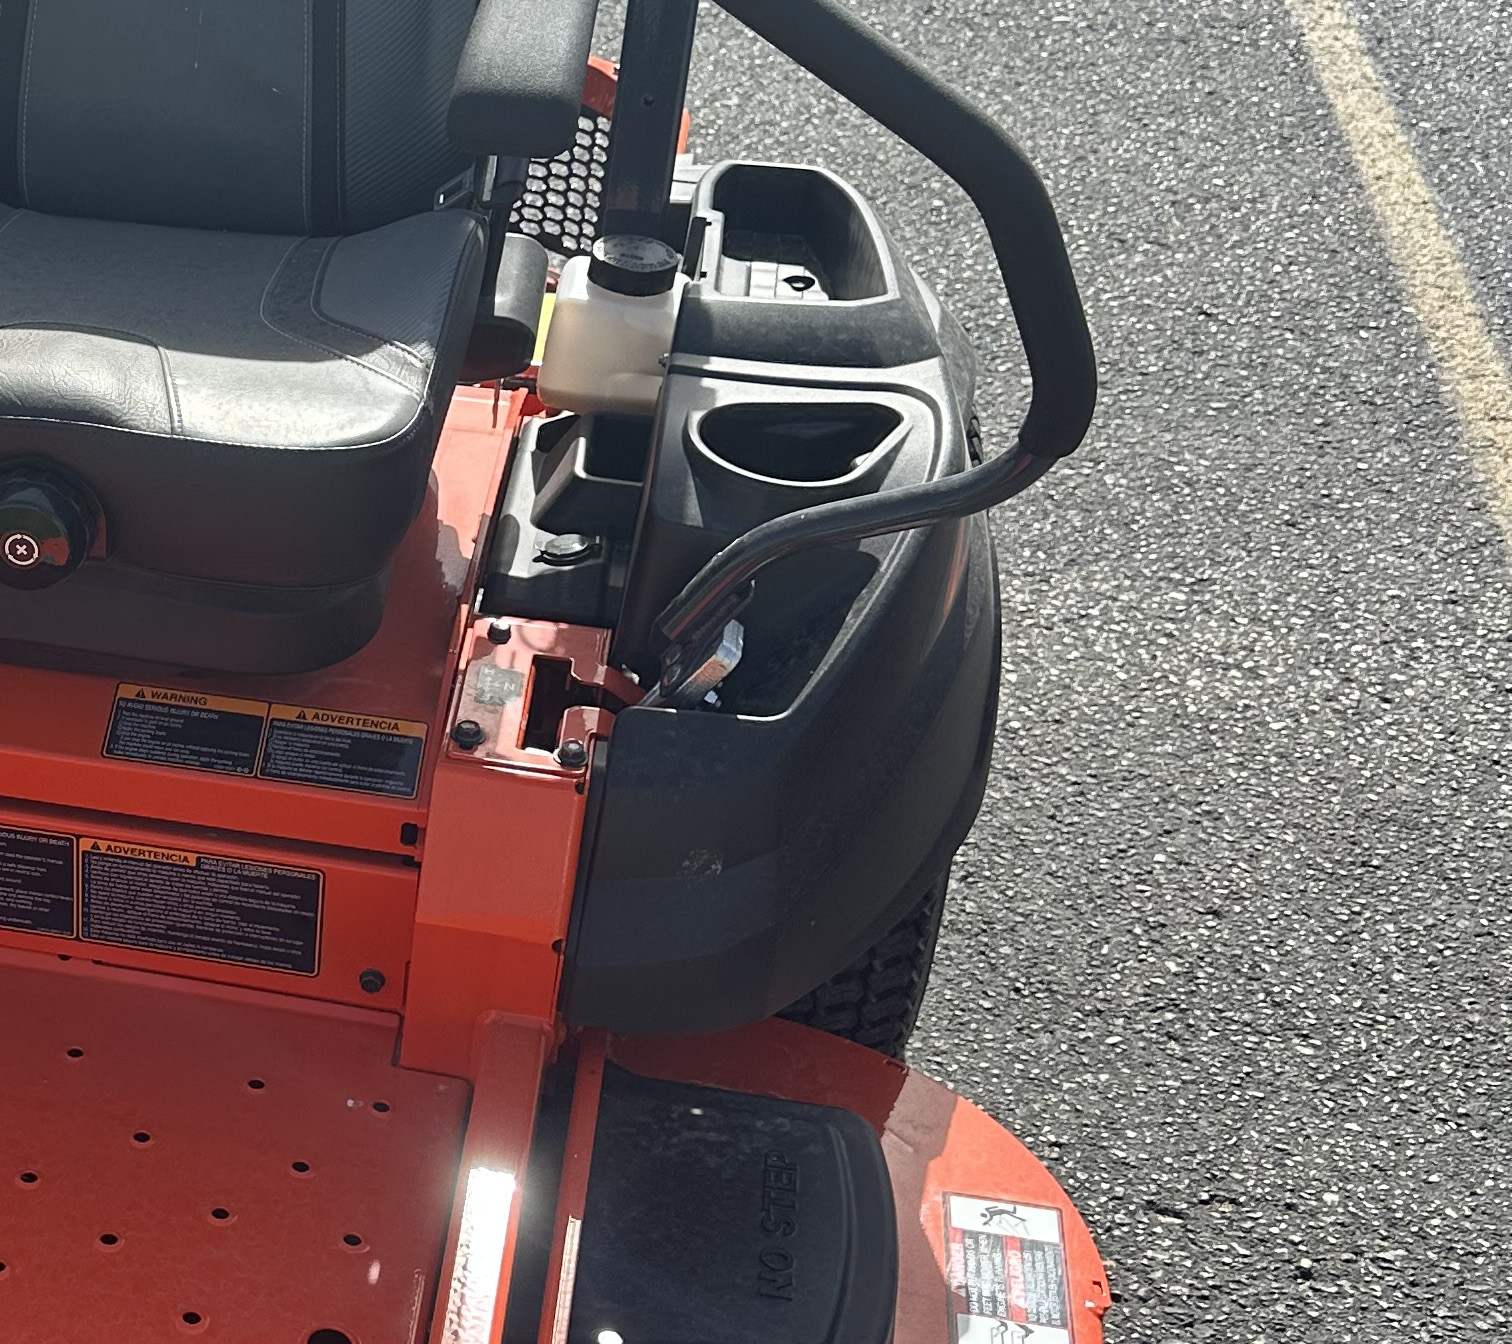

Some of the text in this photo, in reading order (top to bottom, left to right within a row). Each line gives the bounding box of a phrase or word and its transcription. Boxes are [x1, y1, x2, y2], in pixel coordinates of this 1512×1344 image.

[150, 689, 208, 706] WARNING
[311, 711, 400, 732] ADVERTENCIA
[105, 844, 189, 864] ADVERTENCIA
[757, 1149, 799, 1302] NO STEP
